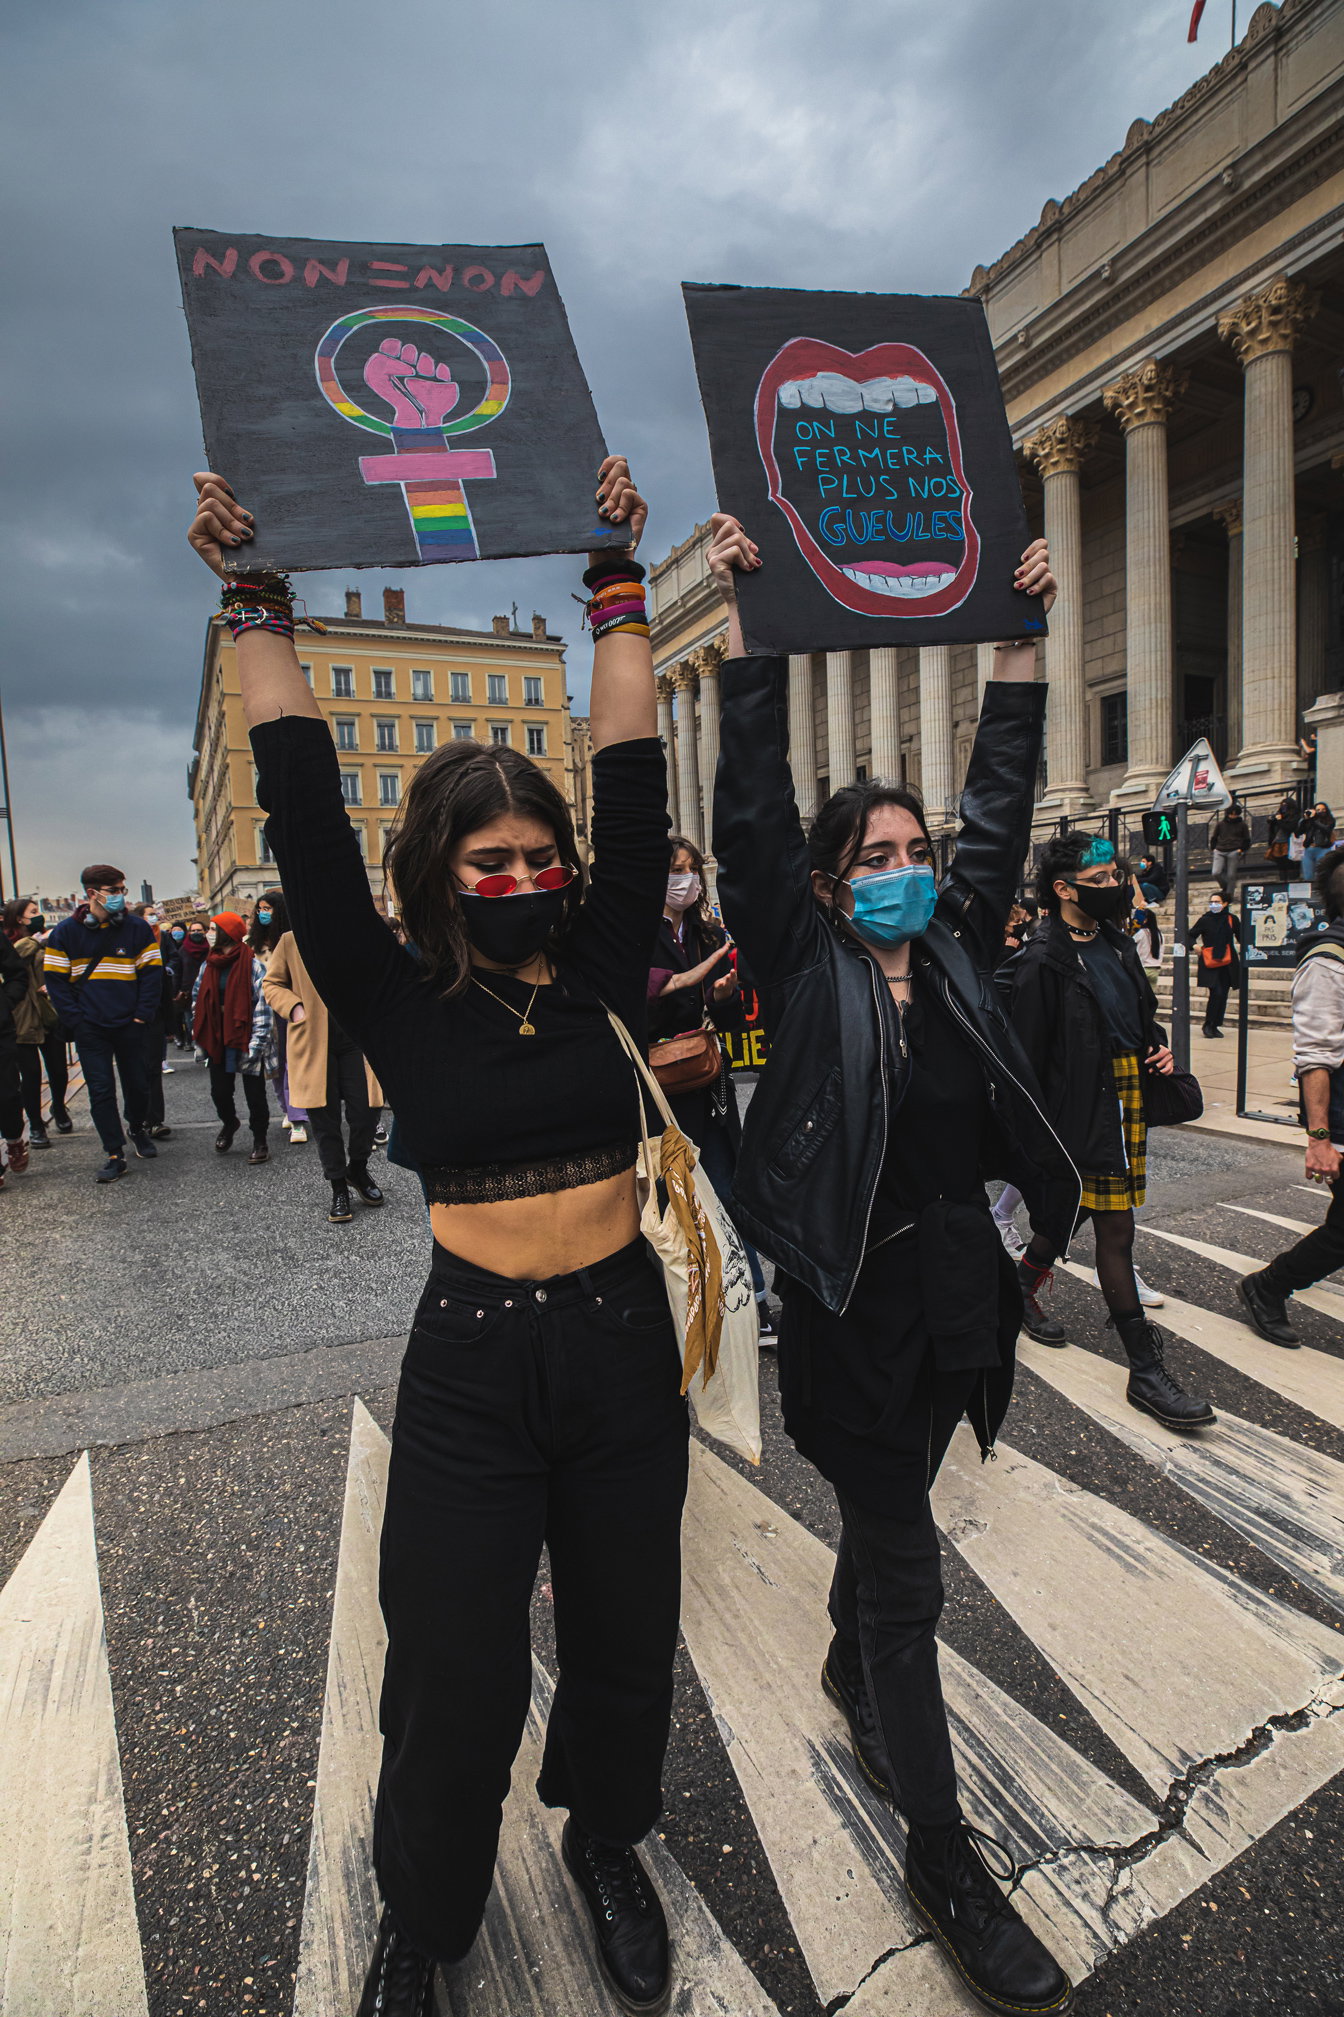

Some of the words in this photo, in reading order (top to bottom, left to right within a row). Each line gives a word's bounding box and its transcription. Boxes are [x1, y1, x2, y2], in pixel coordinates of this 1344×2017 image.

[796, 419, 835, 441] ON
[855, 417, 901, 440] NE
[793, 446, 944, 471] FERMERA
[818, 474, 898, 499] PLUS
[908, 475, 962, 499] NOS
[819, 506, 965, 546] GUEULES
[1261, 934, 1277, 942] PRIS
[1263, 926, 1275, 934] PAS
